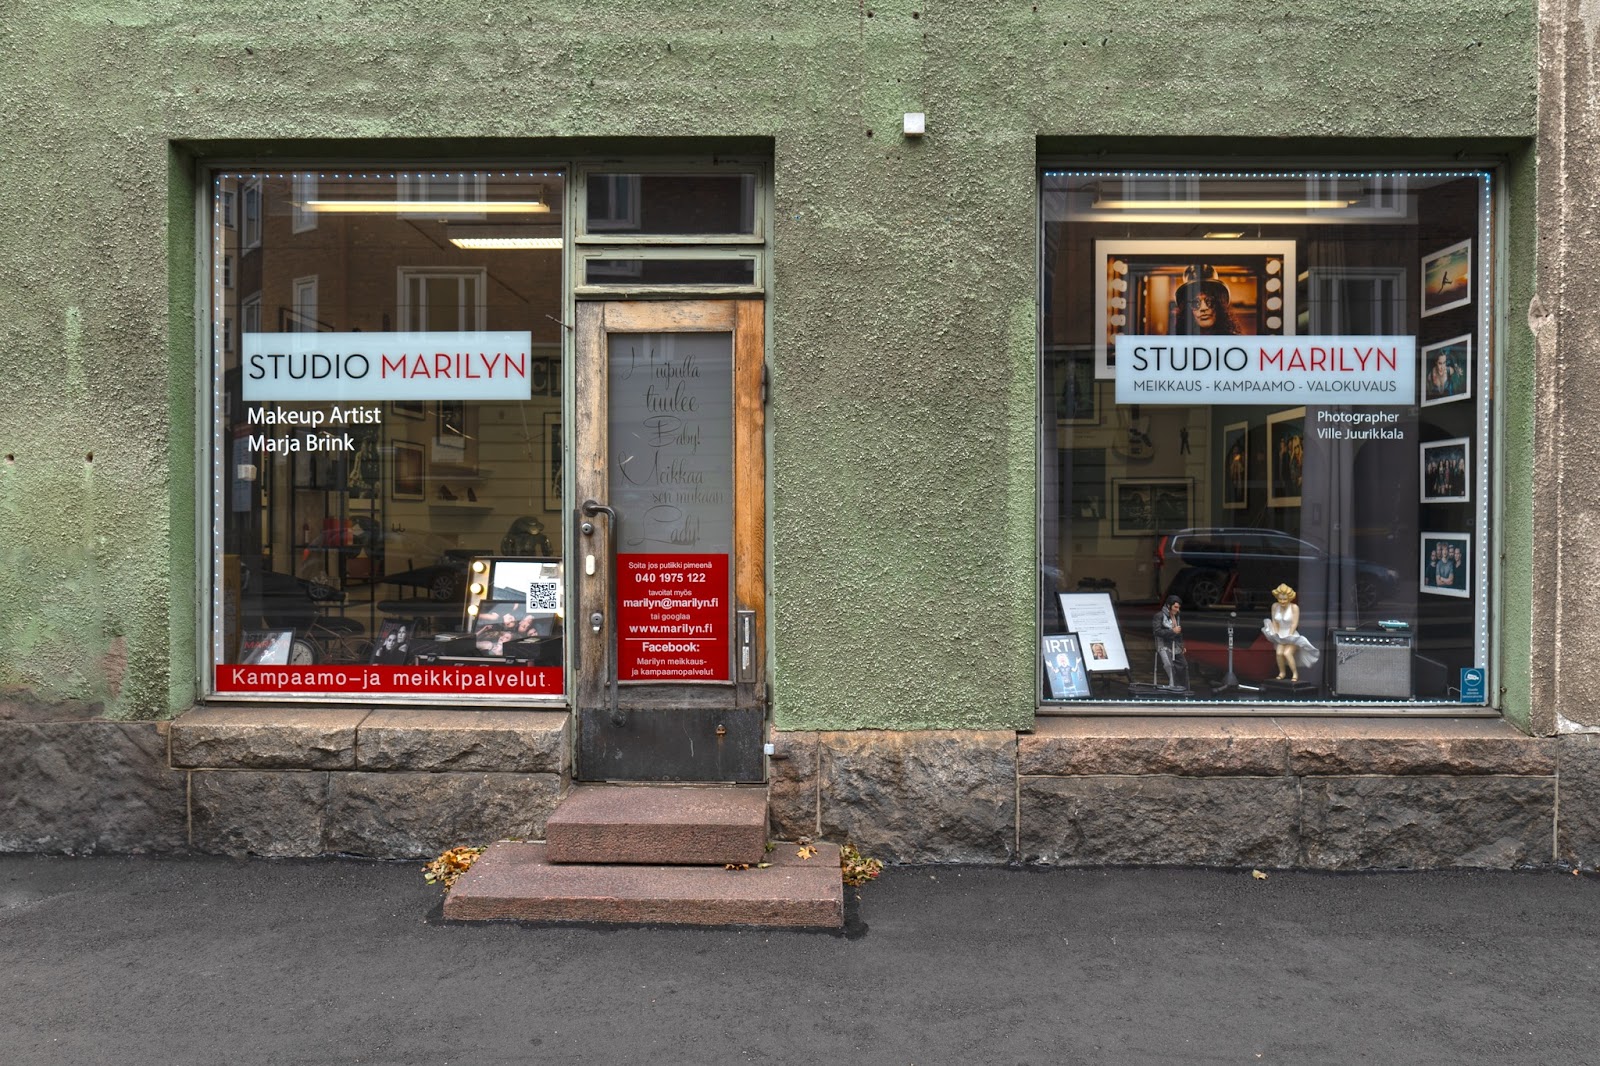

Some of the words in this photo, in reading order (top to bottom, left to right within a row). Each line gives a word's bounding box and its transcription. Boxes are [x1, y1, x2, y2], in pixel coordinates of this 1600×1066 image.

[1133, 347, 1248, 372] STUDIO
[1259, 347, 1397, 372] MARILYN
[248, 354, 370, 380] STUDIO
[381, 353, 526, 379] MARILYN
[1133, 380, 1203, 392] MEIKKAUS
[1213, 380, 1295, 392] KAMPAAMO
[1306, 380, 1397, 392] VALOKUVAUS
[644, 380, 700, 413] tuulee
[247, 406, 325, 428] Makeup
[329, 406, 382, 424] Artist
[1317, 411, 1400, 425] Photographer
[1317, 427, 1343, 440] Ville
[1344, 427, 1404, 441] Juurikkala
[247, 434, 301, 456] Marja
[306, 432, 355, 452] Brink
[628, 561, 647, 570] Soita
[647, 561, 659, 571] jos
[659, 561, 683, 571] putiikki
[683, 561, 713, 571] pimeenä
[635, 572, 656, 583] 040
[659, 572, 684, 583] 1975
[686, 572, 706, 583] 122
[673, 589, 693, 598] myös
[623, 597, 719, 610] marilyn@marilyn.fi
[650, 612, 660, 621] tai
[661, 613, 691, 622] googlaa
[628, 623, 713, 636] www.marilyn.fi
[642, 641, 700, 653] Facebook:
[1045, 638, 1076, 653] IRTI
[636, 657, 666, 667] Marilyn
[667, 657, 707, 667] meikkaus-
[631, 668, 639, 678] ja
[640, 667, 714, 678] kampaamopalvelut
